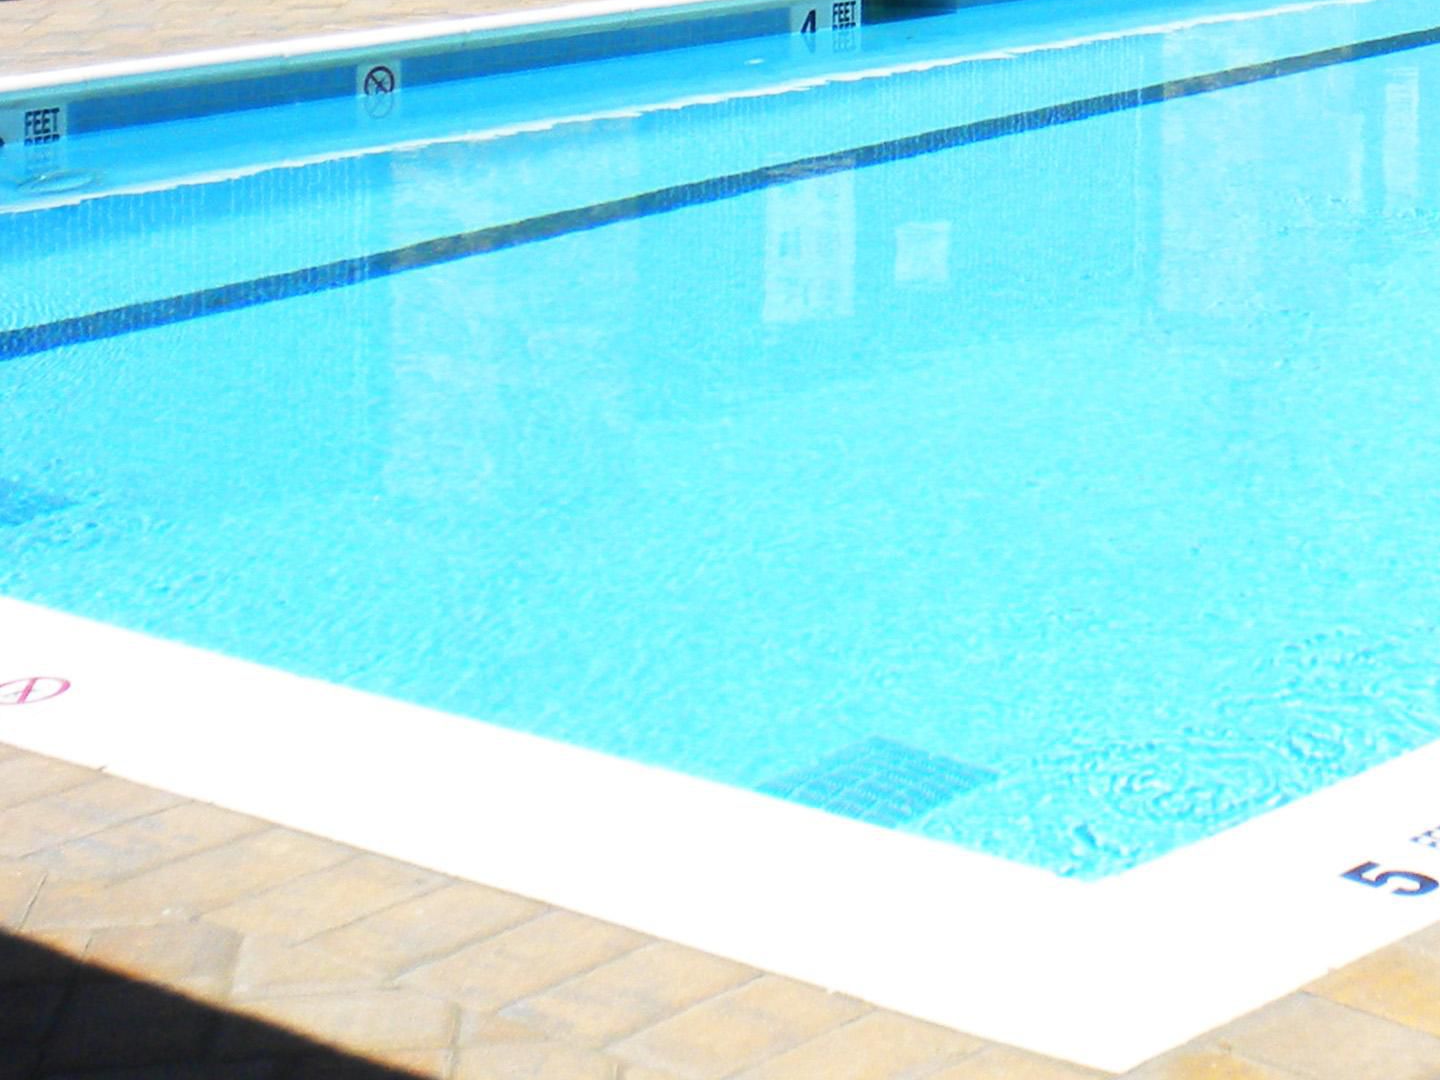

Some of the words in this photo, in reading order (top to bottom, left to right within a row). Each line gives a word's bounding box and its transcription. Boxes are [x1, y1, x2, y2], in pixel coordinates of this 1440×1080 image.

[833, 1, 856, 22] FEET
[24, 107, 60, 137] FEET
[1339, 861, 1440, 896] 5
